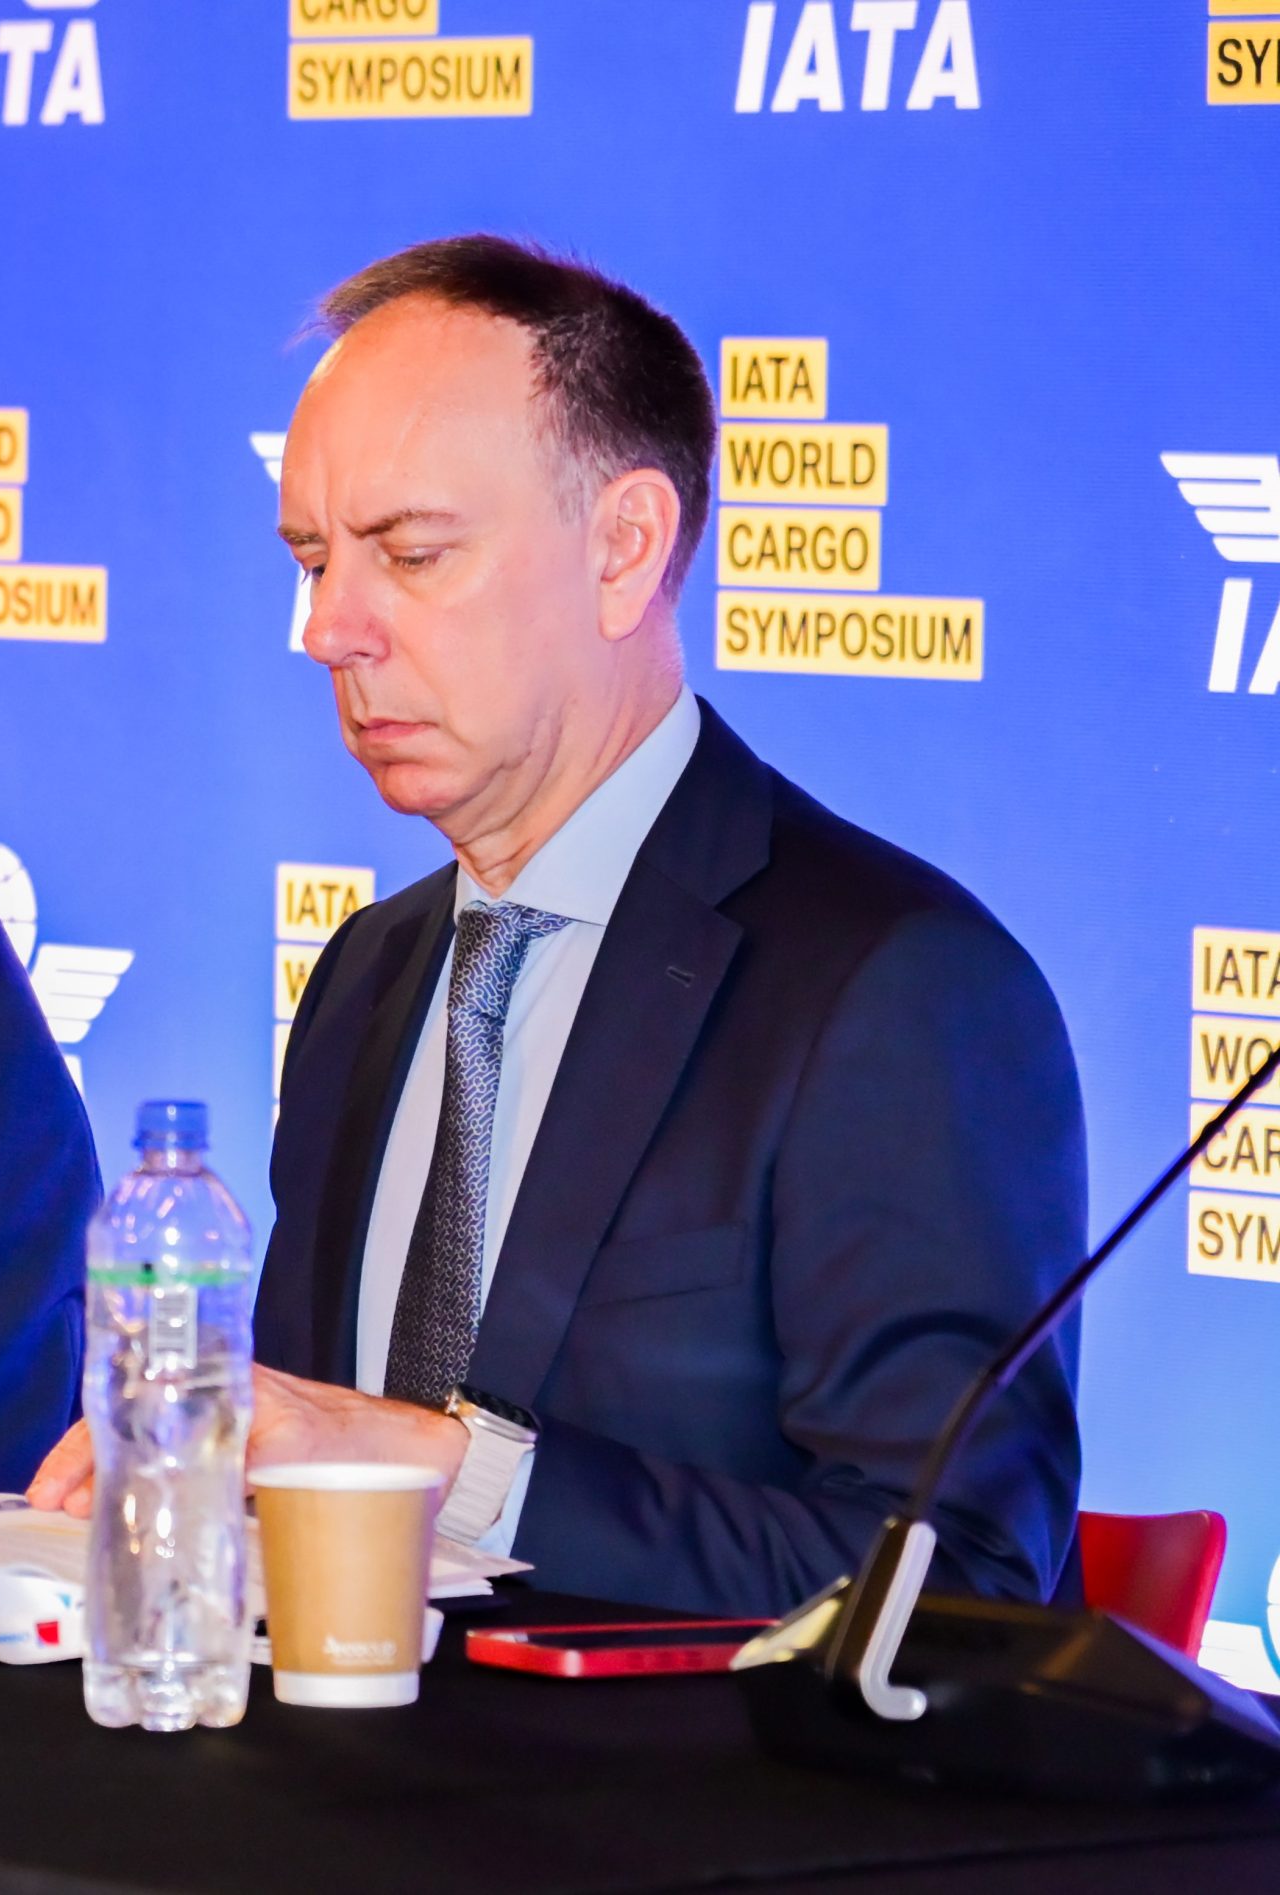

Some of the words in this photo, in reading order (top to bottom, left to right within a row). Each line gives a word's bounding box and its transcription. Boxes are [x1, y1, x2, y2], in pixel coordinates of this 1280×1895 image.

[297, 56, 521, 103] SYMPOSIUM
[734, 0, 980, 113] IATA
[1217, 38, 1280, 87] SY
[730, 355, 814, 402] IATA
[728, 440, 876, 489] WORLD
[727, 523, 869, 574] CARGO
[725, 608, 973, 664] SYMPOSIUM
